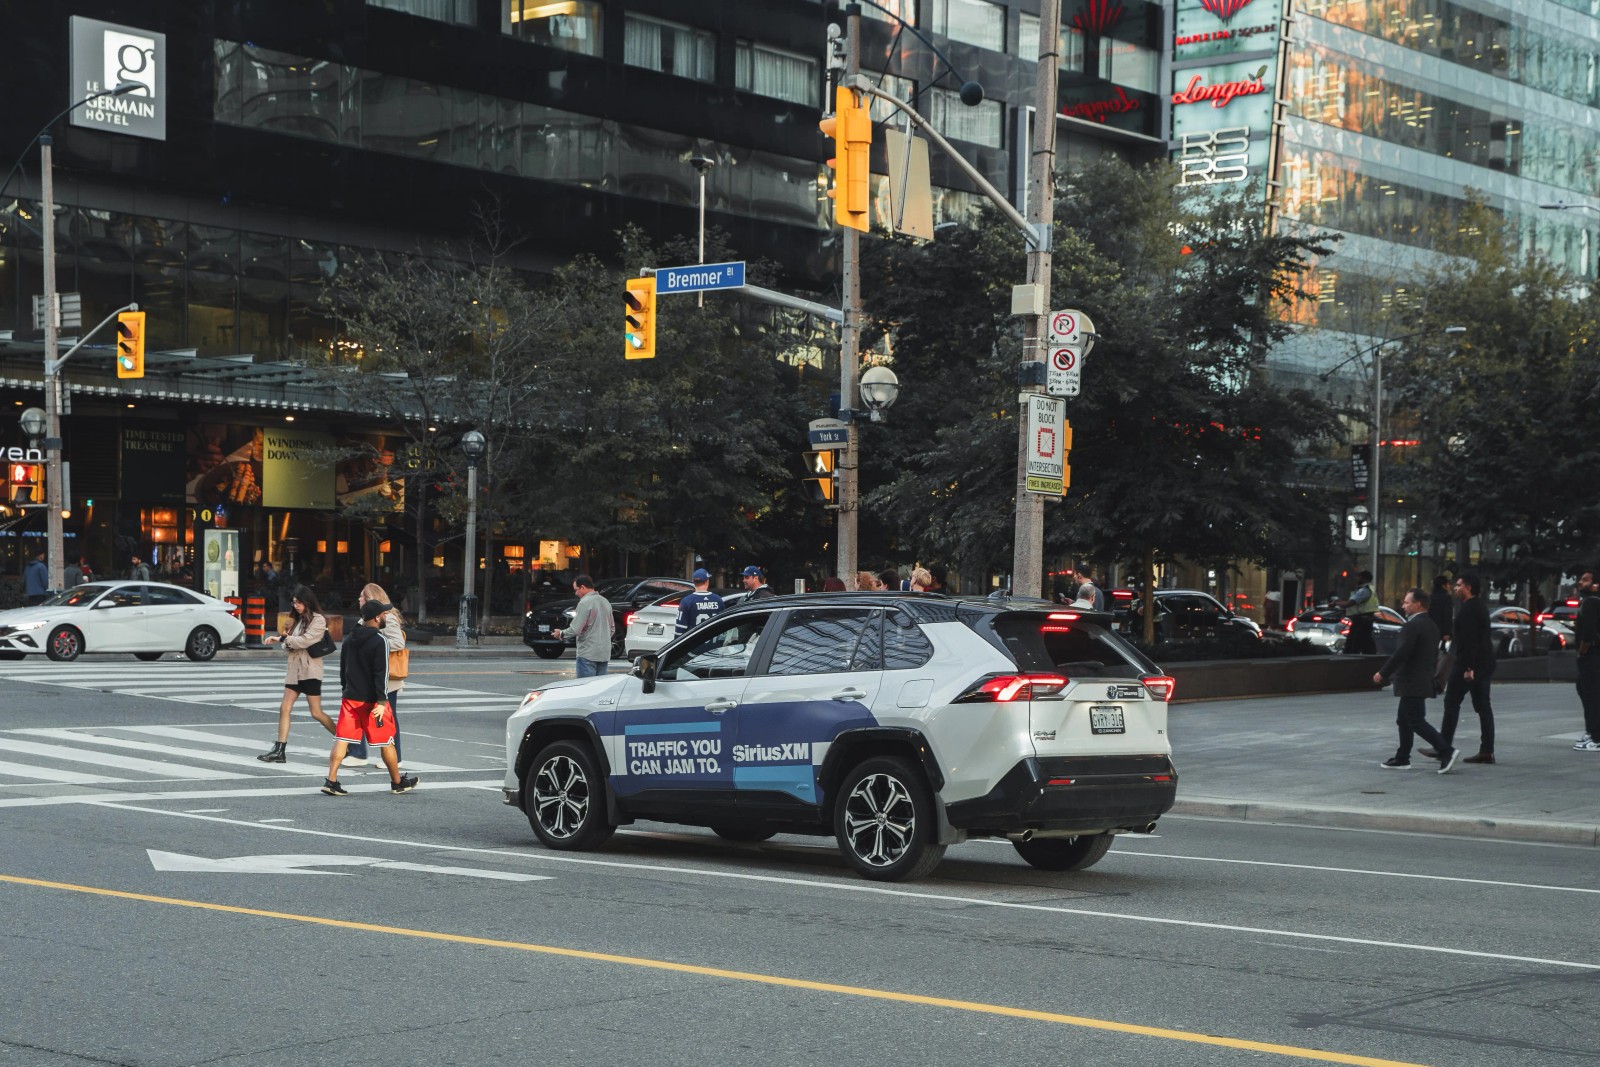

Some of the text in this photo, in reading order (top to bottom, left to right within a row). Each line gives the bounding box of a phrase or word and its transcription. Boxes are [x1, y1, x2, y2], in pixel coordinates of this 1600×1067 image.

[1176, 23, 1276, 46] MAPLE LEAF SQUARE
[86, 80, 99, 93] LE
[85, 93, 155, 119] GERMAIN
[85, 108, 130, 127] HÔTEL
[667, 271, 722, 289] Bremner
[1037, 399, 1058, 413] DO NOT
[1038, 412, 1056, 425] BLOCK
[125, 429, 185, 442] TIME TESTED
[819, 431, 833, 442] York
[125, 440, 175, 452] TREASURE
[267, 437, 314, 449] WINDING
[267, 449, 300, 461] DOWN
[1029, 461, 1062, 475] INTERSECTION
[1028, 479, 1061, 490] FINES INCREASED
[695, 601, 719, 611] TAVARES
[628, 739, 721, 758] TRAFFIC YOU
[732, 742, 809, 762] SiriusXM
[630, 757, 721, 775] CAN JAM TO.
